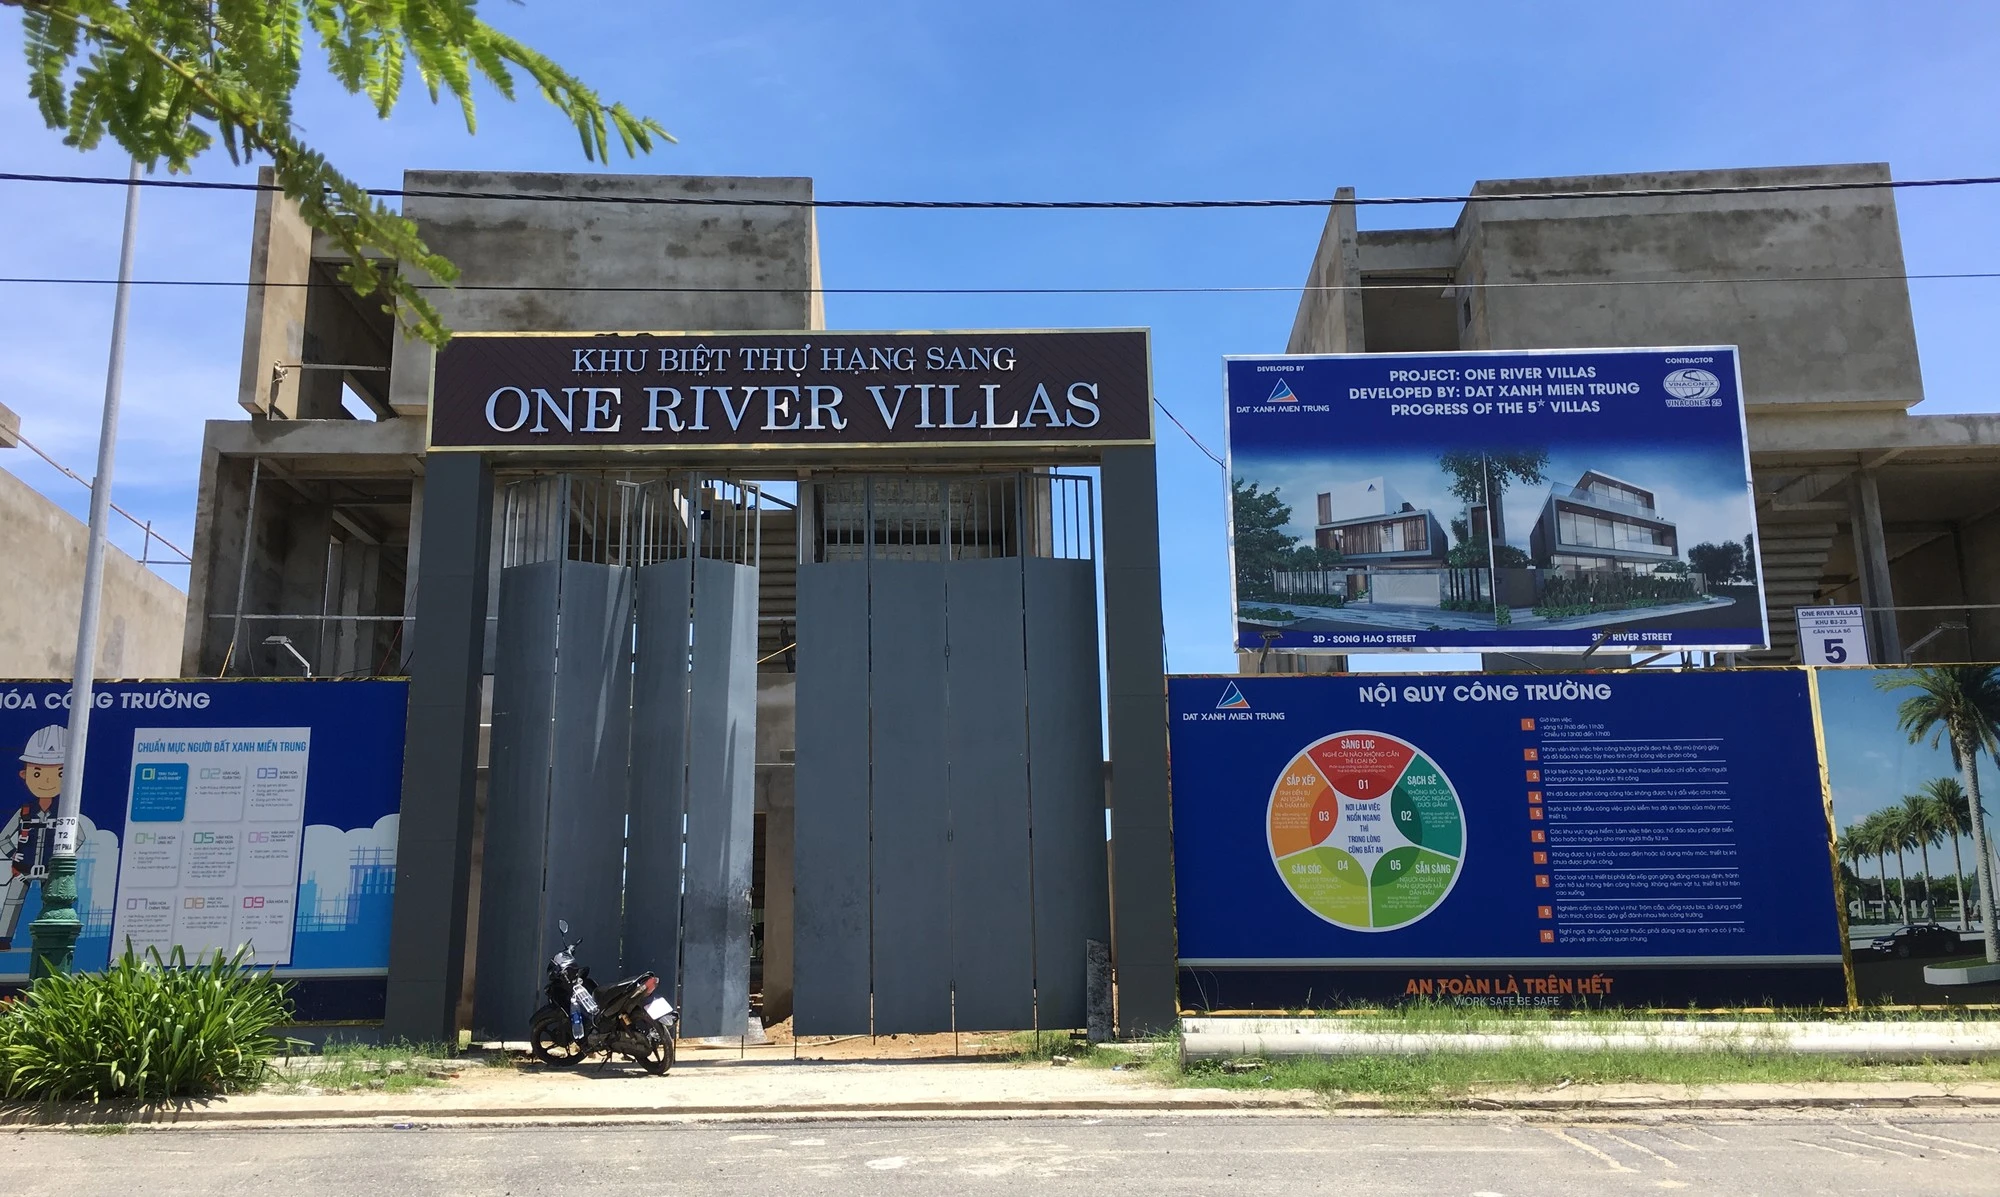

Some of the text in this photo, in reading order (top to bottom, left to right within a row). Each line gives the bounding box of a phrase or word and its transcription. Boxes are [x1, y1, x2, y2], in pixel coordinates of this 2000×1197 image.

[572, 344, 1016, 377] KHU BIỆT THỰ HẠNG SANG
[1390, 366, 1596, 382] PROJECT: ONE RIVER VILLAS
[1349, 382, 1640, 399] DEVELOPED BY: DAT XANH MIEN TRUNG
[486, 383, 1100, 434] ONE RIVER VILLAS
[1392, 403, 1468, 416] PROGRESS
[1473, 403, 1492, 414] OF
[1497, 402, 1523, 414] THE
[1550, 401, 1600, 413] VILLAS
[1665, 399, 1711, 407] VINACONEX
[1313, 635, 1325, 643] 3D
[1333, 635, 1360, 643] SONG
[1363, 635, 1384, 643] HAO
[1387, 635, 1416, 643] STREET
[1613, 633, 1639, 641] RIVER
[1642, 633, 1672, 641] STREET
[1824, 639, 1847, 664] 5
[0, 688, 37, 709] ÓA
[120, 688, 211, 709] TRƯỜNG
[1359, 681, 1612, 707] NỘI QUY CÔNG TRƯỜNG
[138, 739, 306, 754] CHUẨN MỰC NGƯỜI ĐẤT XANH MIỀN TRUNG
[1341, 739, 1375, 751] SÀNG LỌC
[142, 768, 156, 780] 01
[200, 768, 221, 780] 02
[257, 767, 278, 779] 03
[1287, 774, 1316, 786] SẮP XẾP
[1358, 780, 1368, 789] 01
[1407, 774, 1437, 787] SẠCH SẼ
[1368, 803, 1380, 811] VIỆC
[66, 818, 75, 826] 70
[1319, 811, 1329, 821] 03
[1401, 811, 1412, 821] 02
[135, 832, 156, 844] 04
[193, 832, 215, 844] 05
[248, 832, 270, 843] 06
[1367, 835, 1381, 843] LÒNG
[1348, 845, 1363, 854] CŨNG
[1364, 845, 1374, 854] BẤT
[1292, 864, 1322, 875] SĂN SÓC
[1338, 860, 1348, 870] 04
[1390, 860, 1401, 870] 05
[1416, 862, 1451, 874] SẴN SÀNG
[126, 898, 148, 910] 07
[183, 897, 205, 909] 08
[243, 896, 265, 908] 09
[1406, 974, 1613, 996] AN TOÀN LÀ TRÊN HẾT
[1452, 996, 1559, 1008] WORK SAFE BE SAFE
